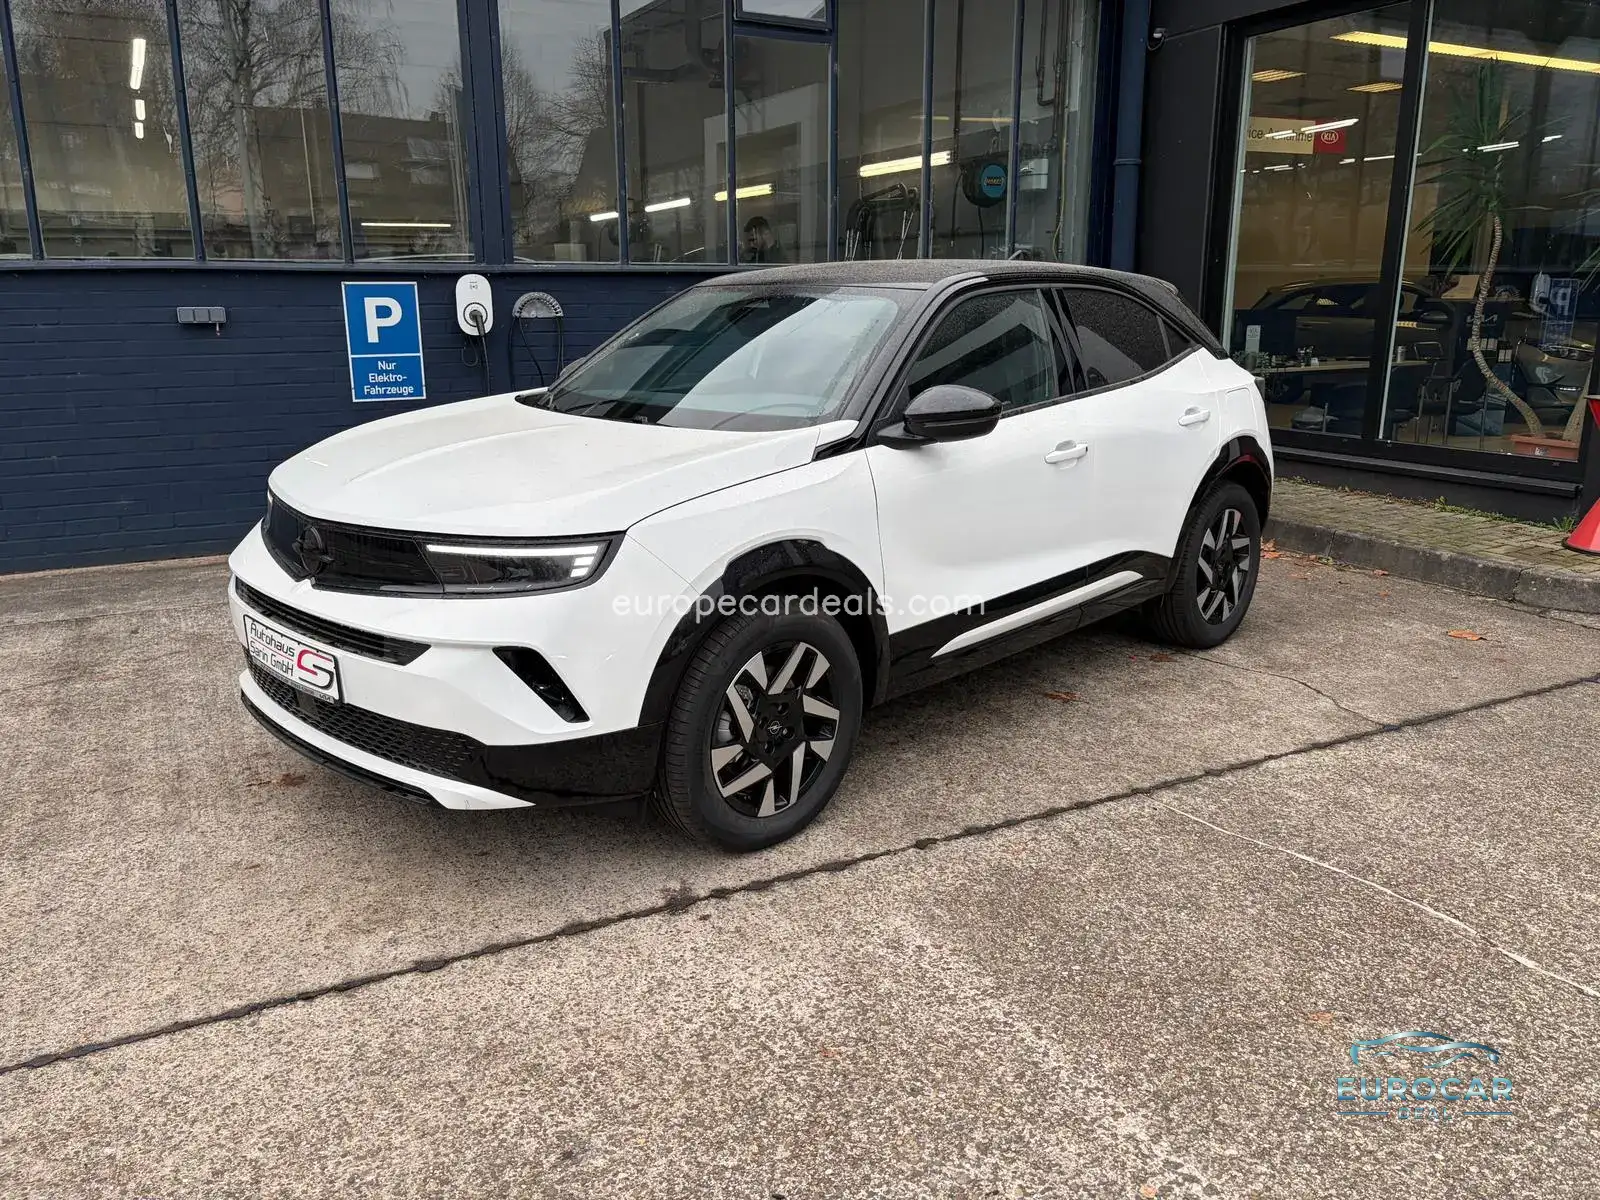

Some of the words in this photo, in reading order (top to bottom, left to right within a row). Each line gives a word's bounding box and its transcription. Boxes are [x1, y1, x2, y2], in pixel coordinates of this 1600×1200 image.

[364, 297, 402, 343] P
[378, 361, 396, 370] Nur
[368, 374, 407, 383] Elektro-
[364, 385, 414, 395] Fahrzeuge
[251, 622, 295, 657] Autohaus
[270, 653, 294, 676] GmbH
